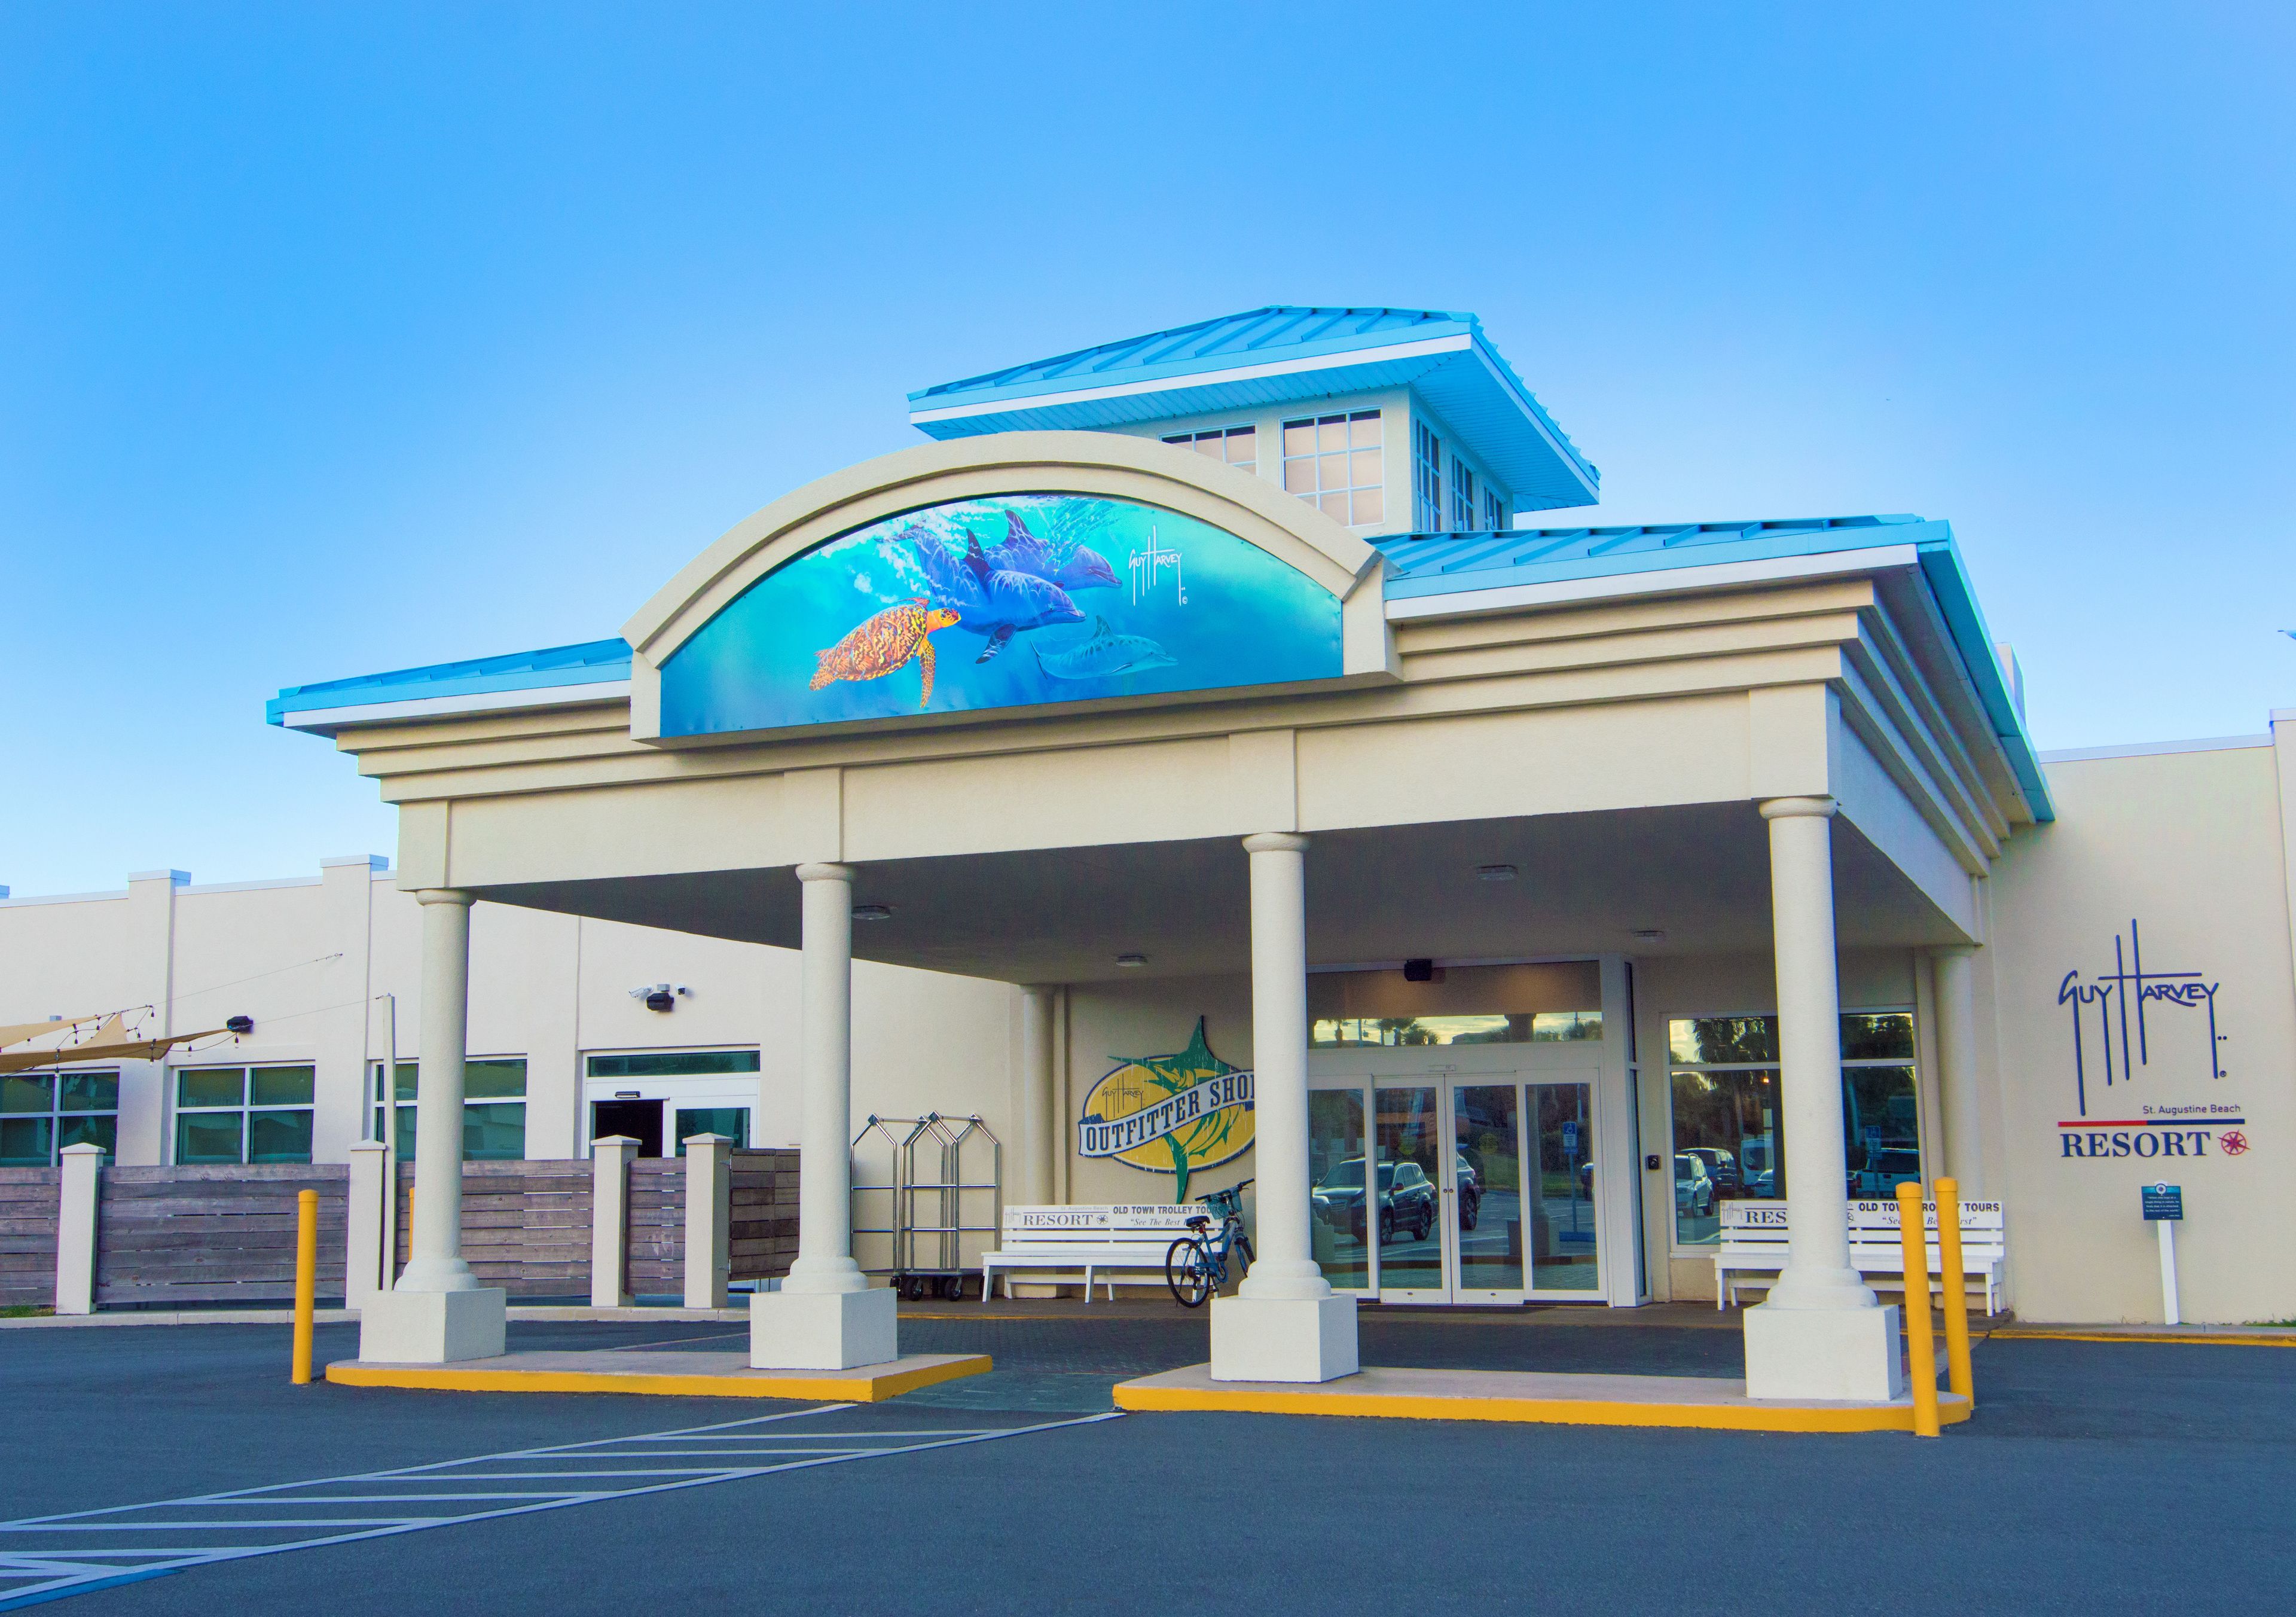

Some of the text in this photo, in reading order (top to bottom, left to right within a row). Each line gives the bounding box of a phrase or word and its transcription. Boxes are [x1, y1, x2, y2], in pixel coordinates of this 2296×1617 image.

[2059, 918, 2219, 1116] GUY HARVEY
[2142, 1103, 2242, 1116] St. Augustine Beach
[1086, 1090, 1200, 1152] OUTFITTER
[2059, 1131, 2211, 1158] RESORT
[1113, 1206, 1128, 1215] OLD
[1131, 1206, 1155, 1215] TOWN
[1158, 1206, 1193, 1215] TROLLEY
[1858, 1203, 1879, 1212] OLD
[1964, 1203, 2000, 1212] TOURS
[1023, 1215, 1094, 1226] RESORT
[1745, 1210, 1787, 1224] RES
